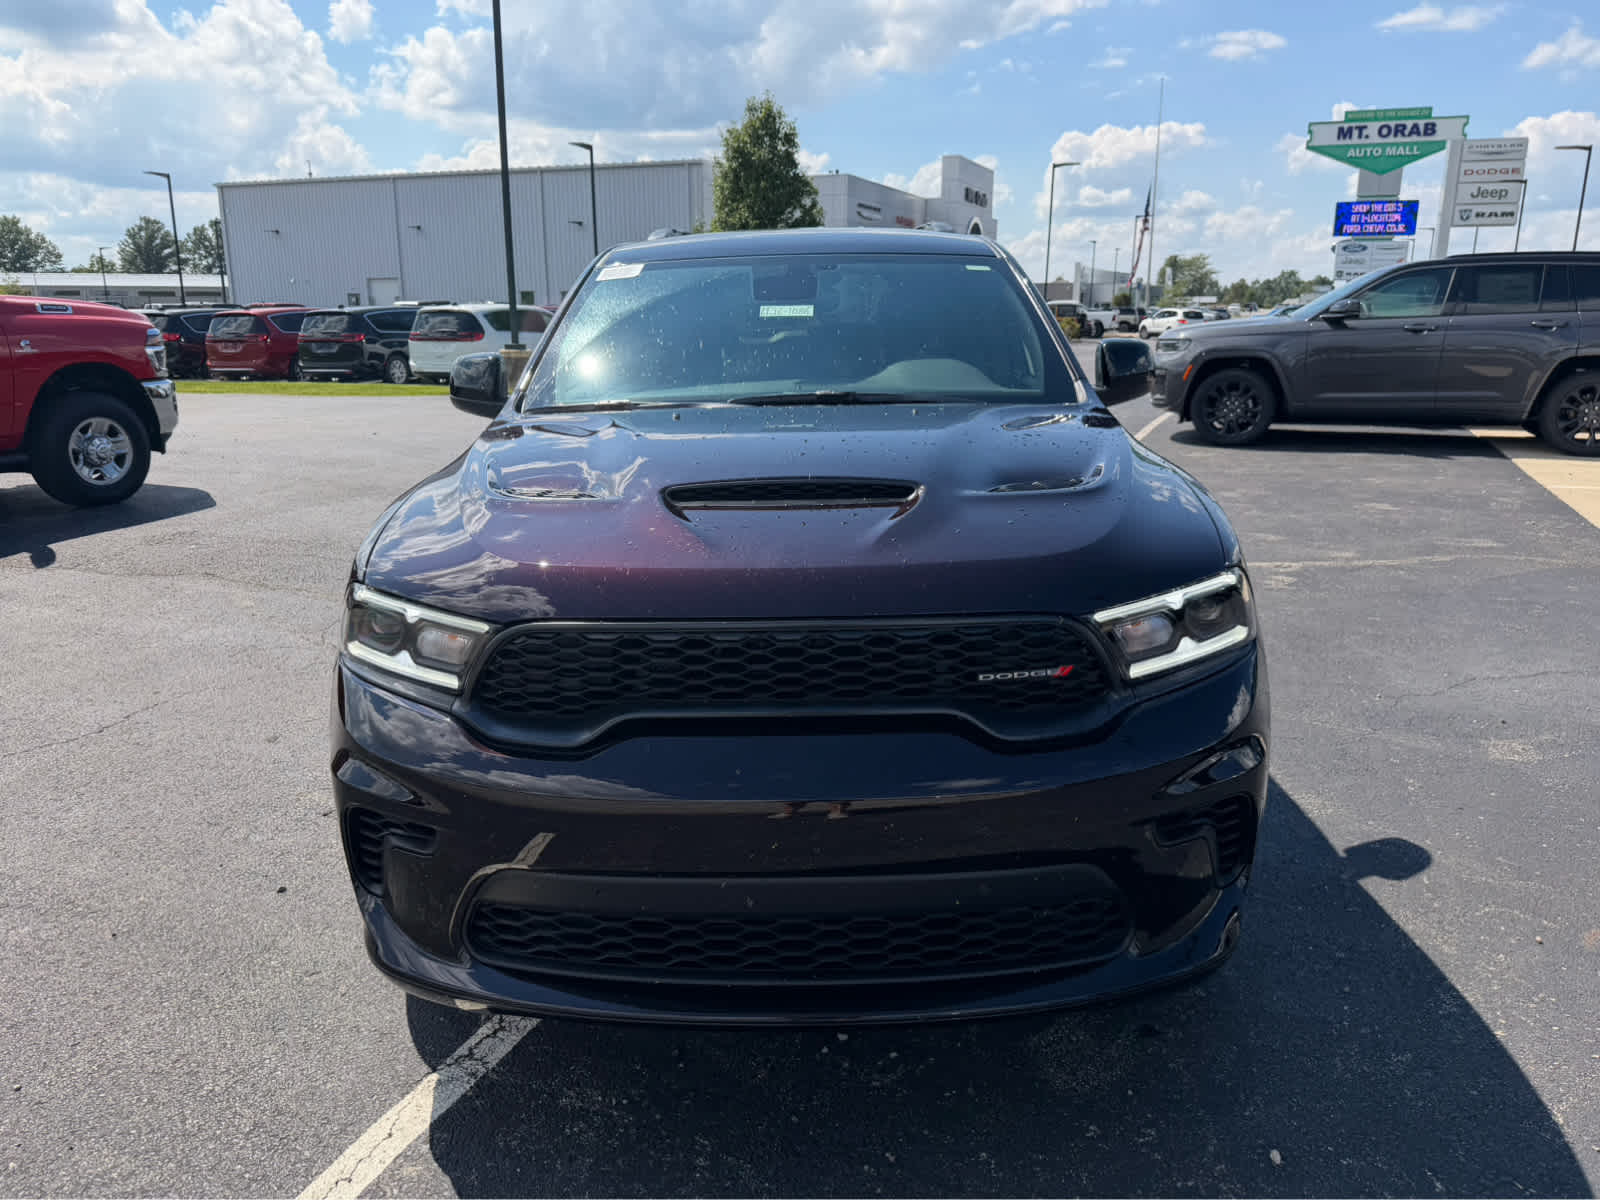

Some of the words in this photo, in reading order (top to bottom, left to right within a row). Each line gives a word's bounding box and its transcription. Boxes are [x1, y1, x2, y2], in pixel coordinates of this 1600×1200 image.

[1337, 125, 1369, 140] MT.
[1377, 122, 1437, 138] ORAB
[1347, 146, 1382, 158] AUTO
[1385, 145, 1420, 156] MALL
[1463, 167, 1521, 176] DODGE
[1470, 186, 1509, 201] Jeep
[1371, 203, 1383, 212] THE
[979, 668, 1058, 680] DODGE
